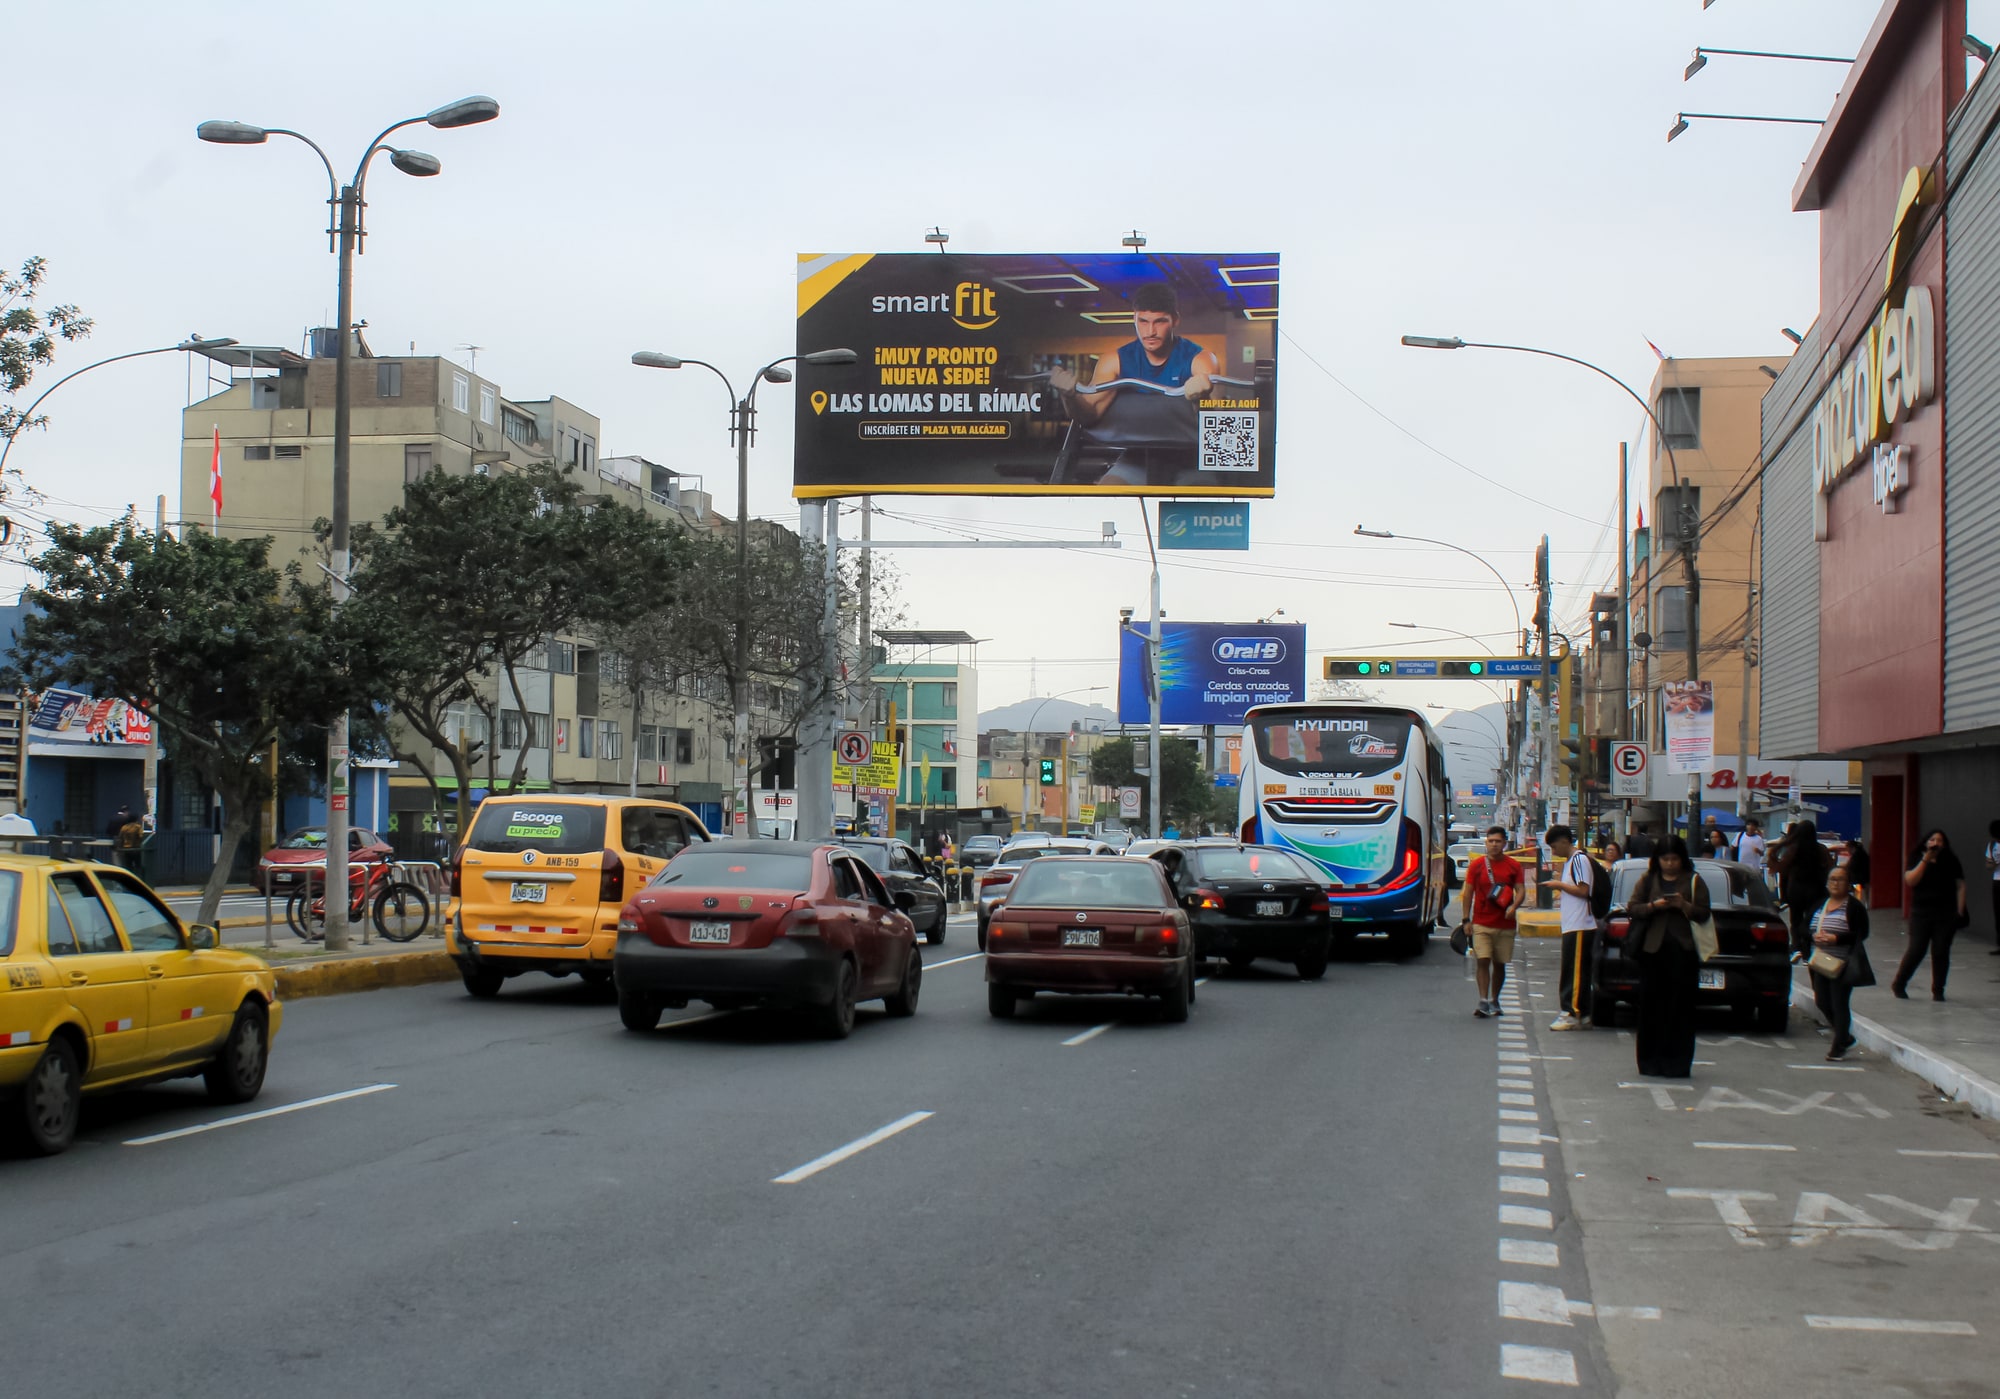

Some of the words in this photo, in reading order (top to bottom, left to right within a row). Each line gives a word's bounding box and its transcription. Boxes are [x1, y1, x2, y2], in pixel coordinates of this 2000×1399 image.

[872, 293, 949, 313] smart
[955, 282, 996, 317] fit
[874, 347, 921, 365] ¡MUY
[926, 347, 998, 365] PRONTO
[881, 368, 938, 385] NUEVA
[943, 367, 990, 385] SEDE!
[830, 393, 863, 413] LAS
[869, 393, 934, 413] LOMAS
[940, 393, 973, 413] DEL
[979, 388, 1041, 413] RÍMAC
[1200, 399, 1236, 408] EMPIEZA
[1238, 397, 1259, 408] AQUÍ
[864, 424, 908, 435] INSCRÍBETE
[910, 426, 920, 435] EN
[922, 426, 949, 435] PLAZA
[951, 426, 967, 435] VEA
[969, 423, 1006, 435] ALCÁZAR
[1874, 443, 1910, 514] hiper
[1193, 514, 1242, 529] input
[1218, 643, 1279, 658] Oral-B
[1228, 667, 1270, 675] Criss-Cross
[1208, 681, 1242, 690] Cerdas
[1246, 681, 1290, 690] cruzadas
[1204, 692, 1249, 704] limpian
[1295, 720, 1367, 731] HYUNDAI
[128, 731, 150, 740] JUNIO
[1042, 761, 1052, 769] 54
[1623, 751, 1637, 770] E
[1707, 769, 1790, 789] Bta
[512, 811, 563, 825] Escoge
[523, 827, 559, 836] precio
[546, 857, 579, 867] ANB-159
[512, 885, 543, 899] ANB-159
[692, 927, 728, 940] A1J-413
[1617, 1081, 1892, 1119] TAXI
[1666, 1187, 2000, 1250] TAX
